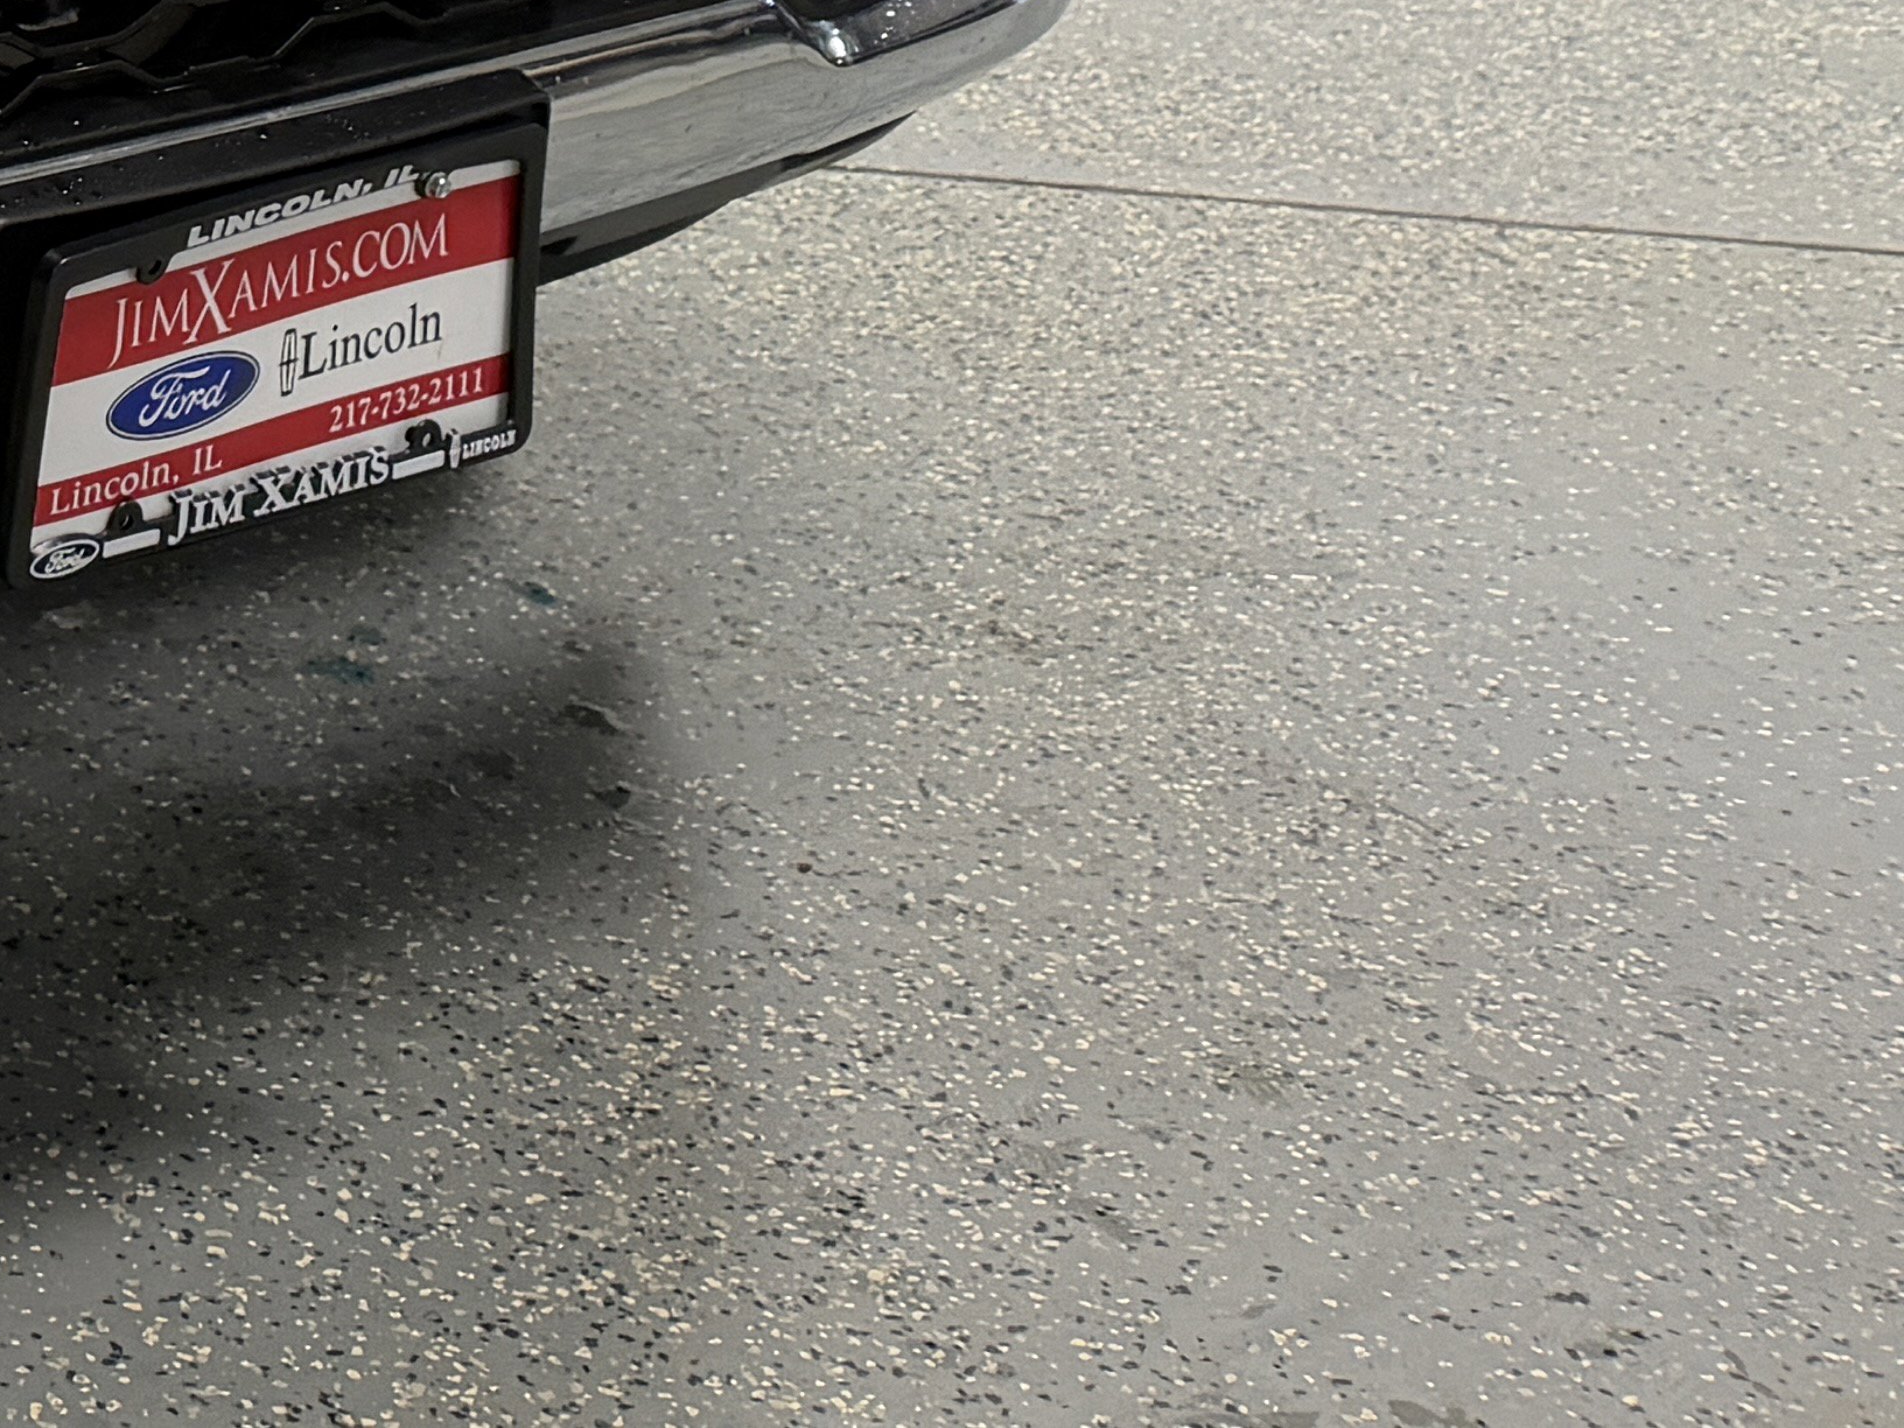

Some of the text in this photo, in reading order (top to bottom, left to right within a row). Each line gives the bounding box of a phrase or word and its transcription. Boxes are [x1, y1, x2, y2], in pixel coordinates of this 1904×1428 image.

[187, 178, 373, 248] LINCOLN,
[107, 212, 449, 370] JIMXAMIS.COM
[297, 302, 443, 380] Lincoln
[327, 366, 485, 433] 217-732-2111
[50, 443, 223, 515] Lincoln, IL
[167, 447, 390, 546] JIM XAMIS
